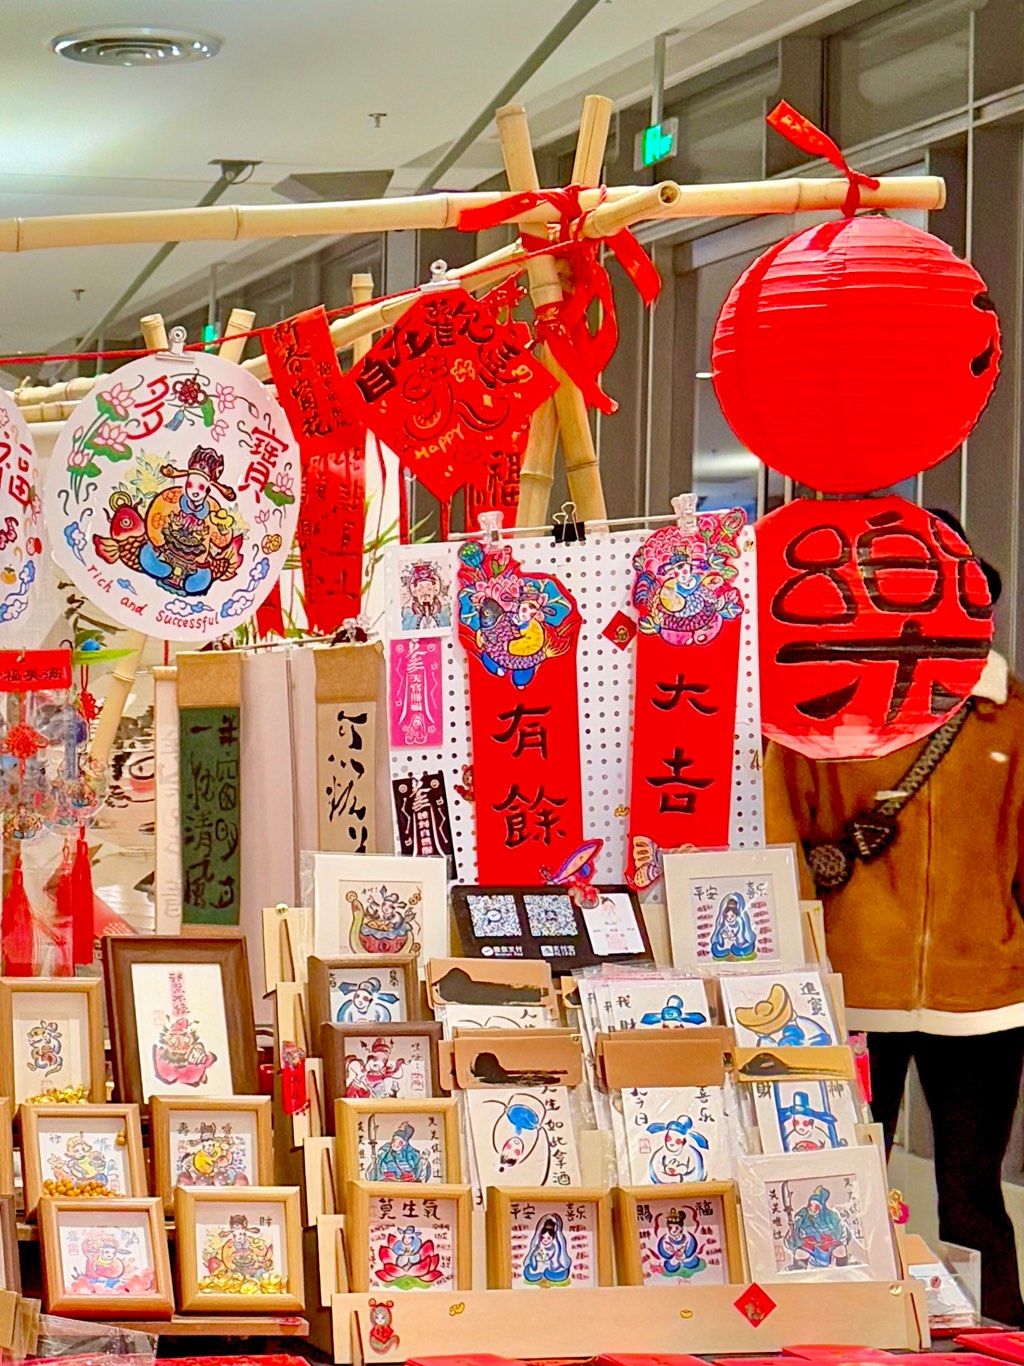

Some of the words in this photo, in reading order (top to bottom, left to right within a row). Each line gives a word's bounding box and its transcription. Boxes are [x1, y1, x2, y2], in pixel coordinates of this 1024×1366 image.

[127, 375, 169, 439] 多
[87, 564, 112, 592] rich
[120, 596, 145, 616] and
[156, 610, 219, 633] successful
[491, 702, 568, 848] 有餘
[645, 673, 719, 814] 大吉
[694, 885, 718, 900] 平安
[510, 1203, 536, 1220] 平安
[695, 1200, 714, 1217] 福
